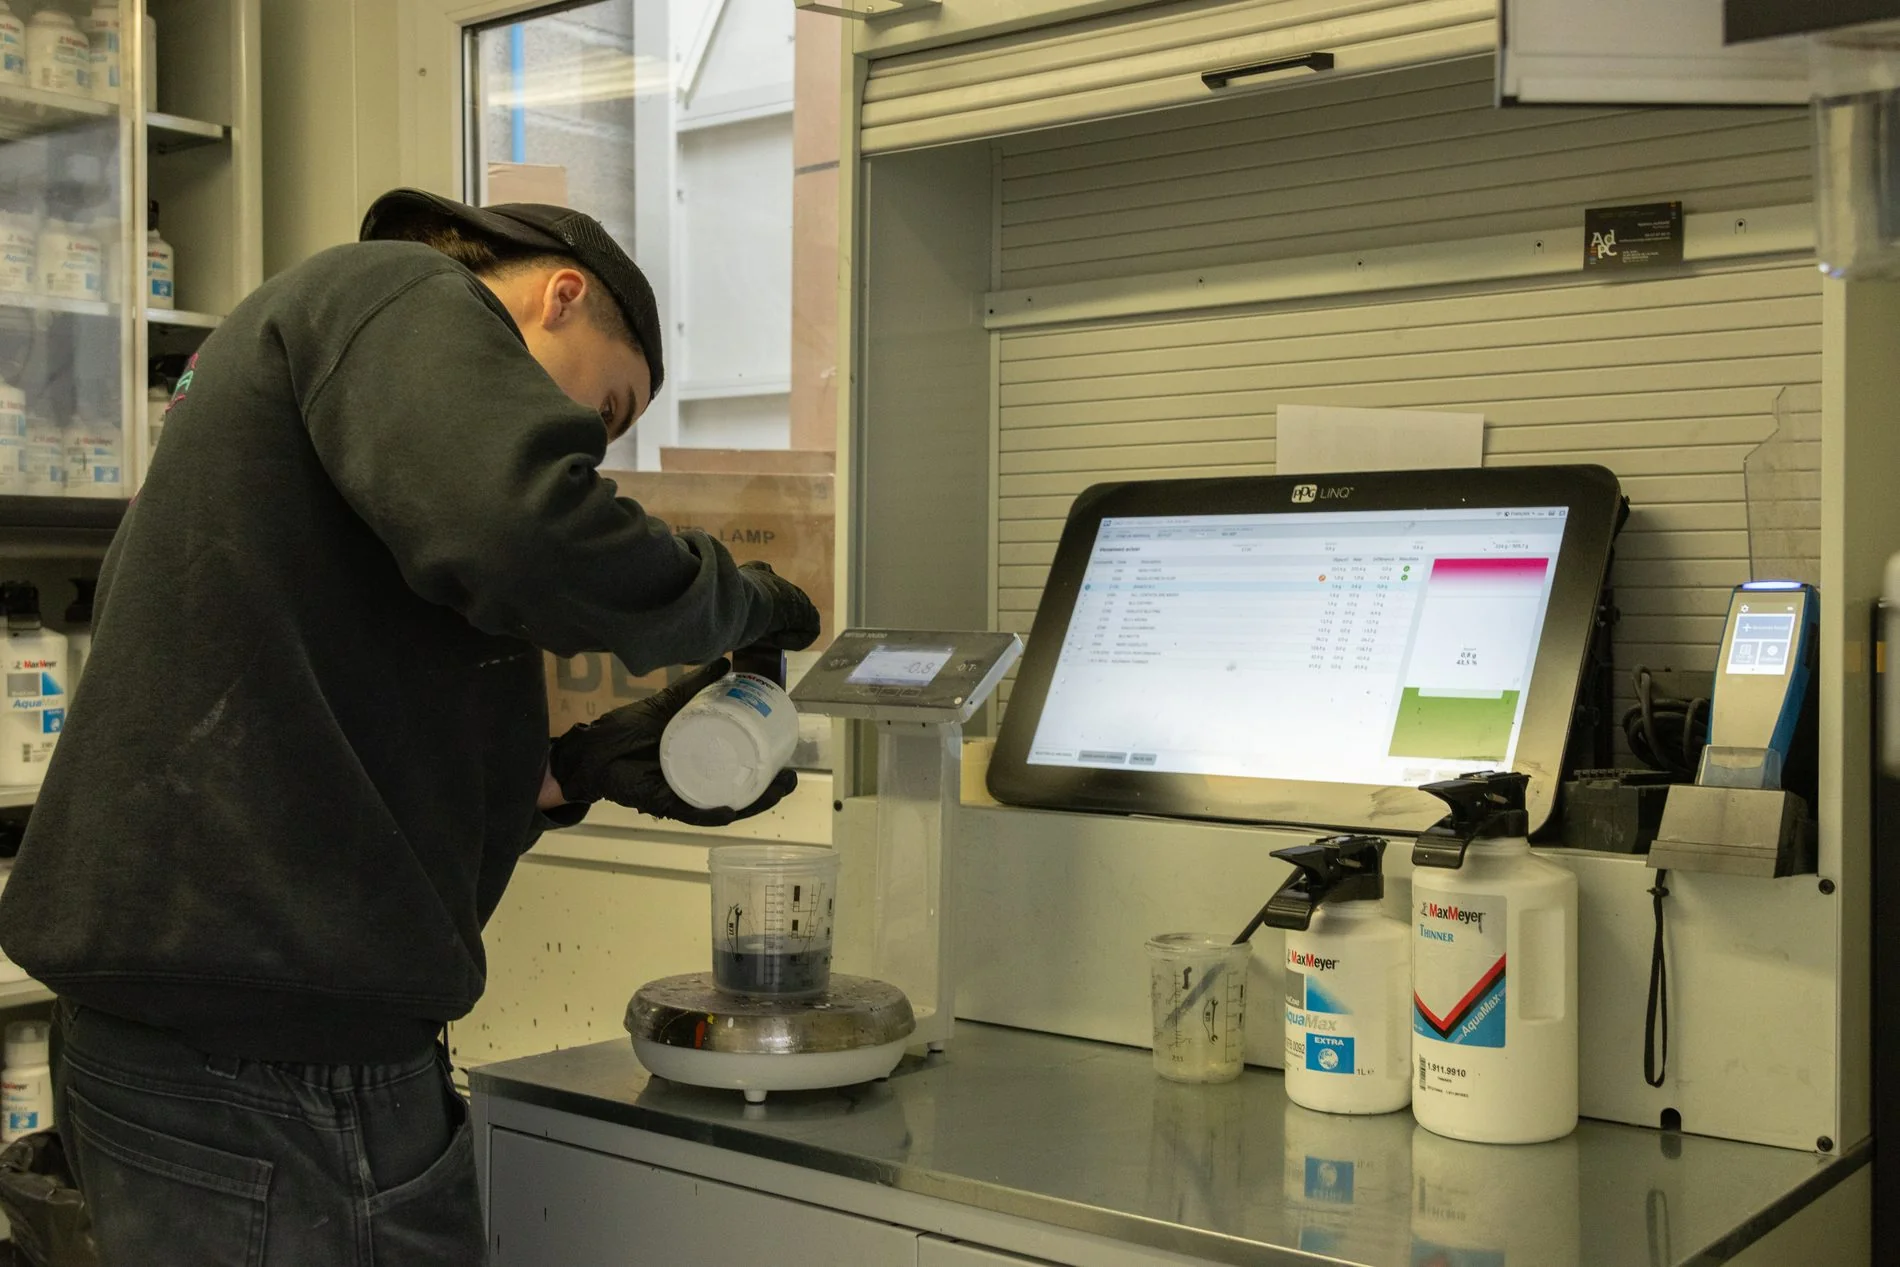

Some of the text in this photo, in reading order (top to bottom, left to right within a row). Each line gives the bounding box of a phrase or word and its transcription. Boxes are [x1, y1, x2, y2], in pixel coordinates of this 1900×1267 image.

[721, 527, 776, 546] LAMP
[1429, 903, 1483, 924] MaxMeyer
[1291, 949, 1337, 971] MaxMeyer
[1461, 993, 1501, 1038] AquaMax
[1314, 1035, 1345, 1047] EXTRA
